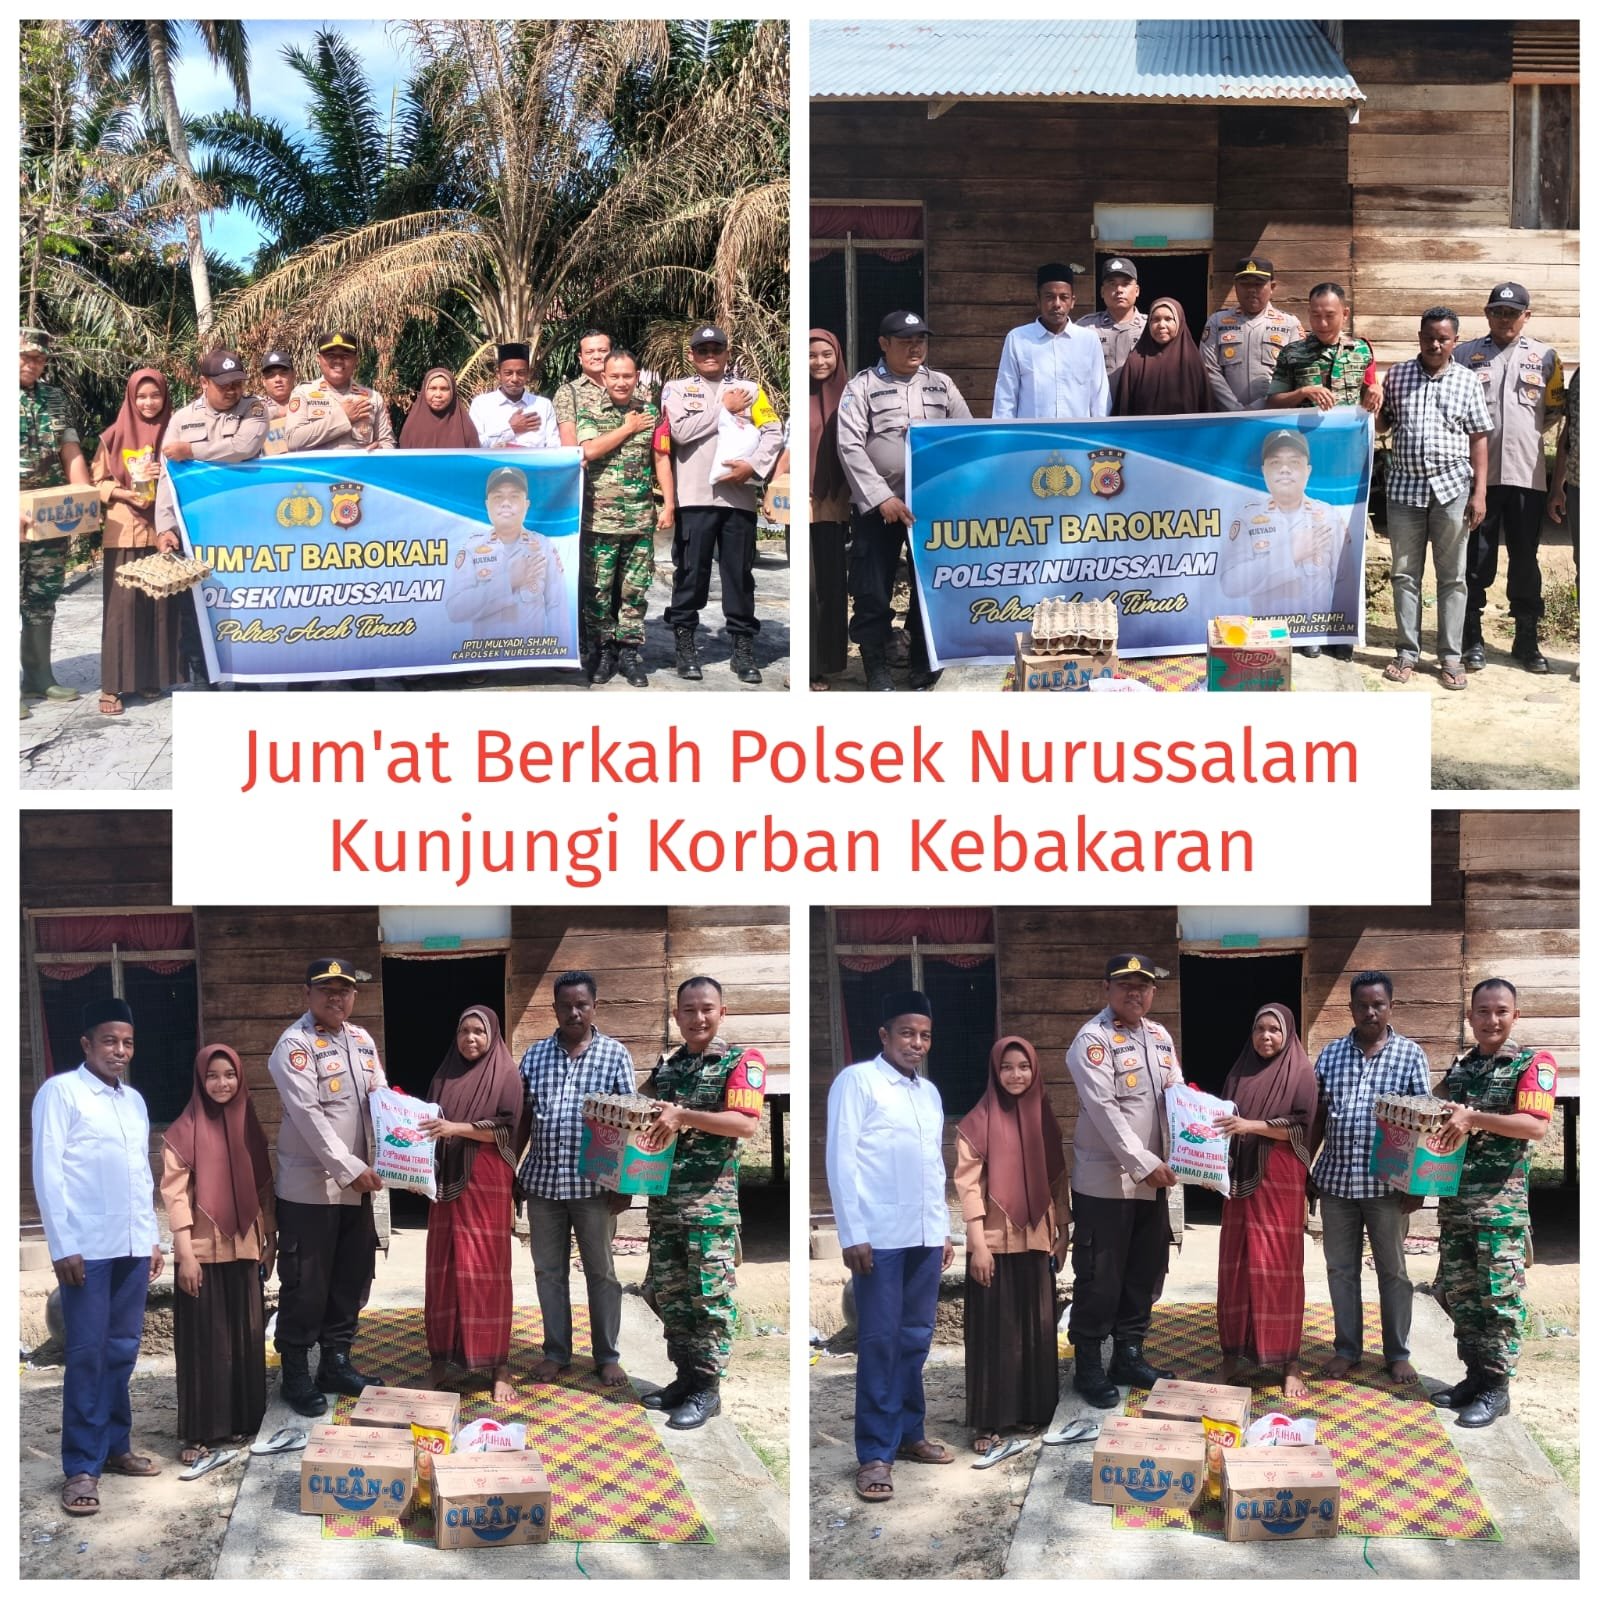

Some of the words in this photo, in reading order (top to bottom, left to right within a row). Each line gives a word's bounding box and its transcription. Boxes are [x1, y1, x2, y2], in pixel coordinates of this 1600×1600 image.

[1090, 451, 1123, 459] ACEH
[332, 483, 361, 491] ACEH
[36, 501, 98, 523] CLEAN-Q
[925, 516, 1053, 550] JUM'AT
[1060, 509, 1220, 543] BAROKAH
[193, 544, 295, 573] UM'AT
[301, 539, 448, 571] BAROKAH
[932, 560, 1040, 589] POLSEK
[1040, 552, 1218, 584] NURUSSALAM
[202, 587, 280, 609] OLSEK
[281, 579, 444, 608] NURUSSALAM
[1122, 589, 1188, 615] Timur
[216, 619, 286, 643] Polres
[285, 615, 355, 643] Aceh
[355, 614, 416, 637] Timur
[1311, 614, 1344, 623] SH.MH
[452, 651, 499, 660] KAPOLSEK
[504, 648, 567, 657] NURUSSALAM
[463, 640, 483, 650] IPTU
[527, 638, 558, 647] SH.MH
[728, 1089, 764, 1112] BABIN
[1518, 1091, 1554, 1113] BABIN
[377, 1169, 408, 1181] RAHMAD
[410, 1175, 430, 1184] BARU
[1171, 1164, 1202, 1177] RAHMAD
[1203, 1171, 1223, 1181] BARU
[308, 1475, 406, 1501] CLEAN-Q
[1100, 1466, 1196, 1492] CLEAN-Q
[445, 1503, 545, 1527] CLEAN-Q
[1235, 1499, 1334, 1521] CLEAN-Q
